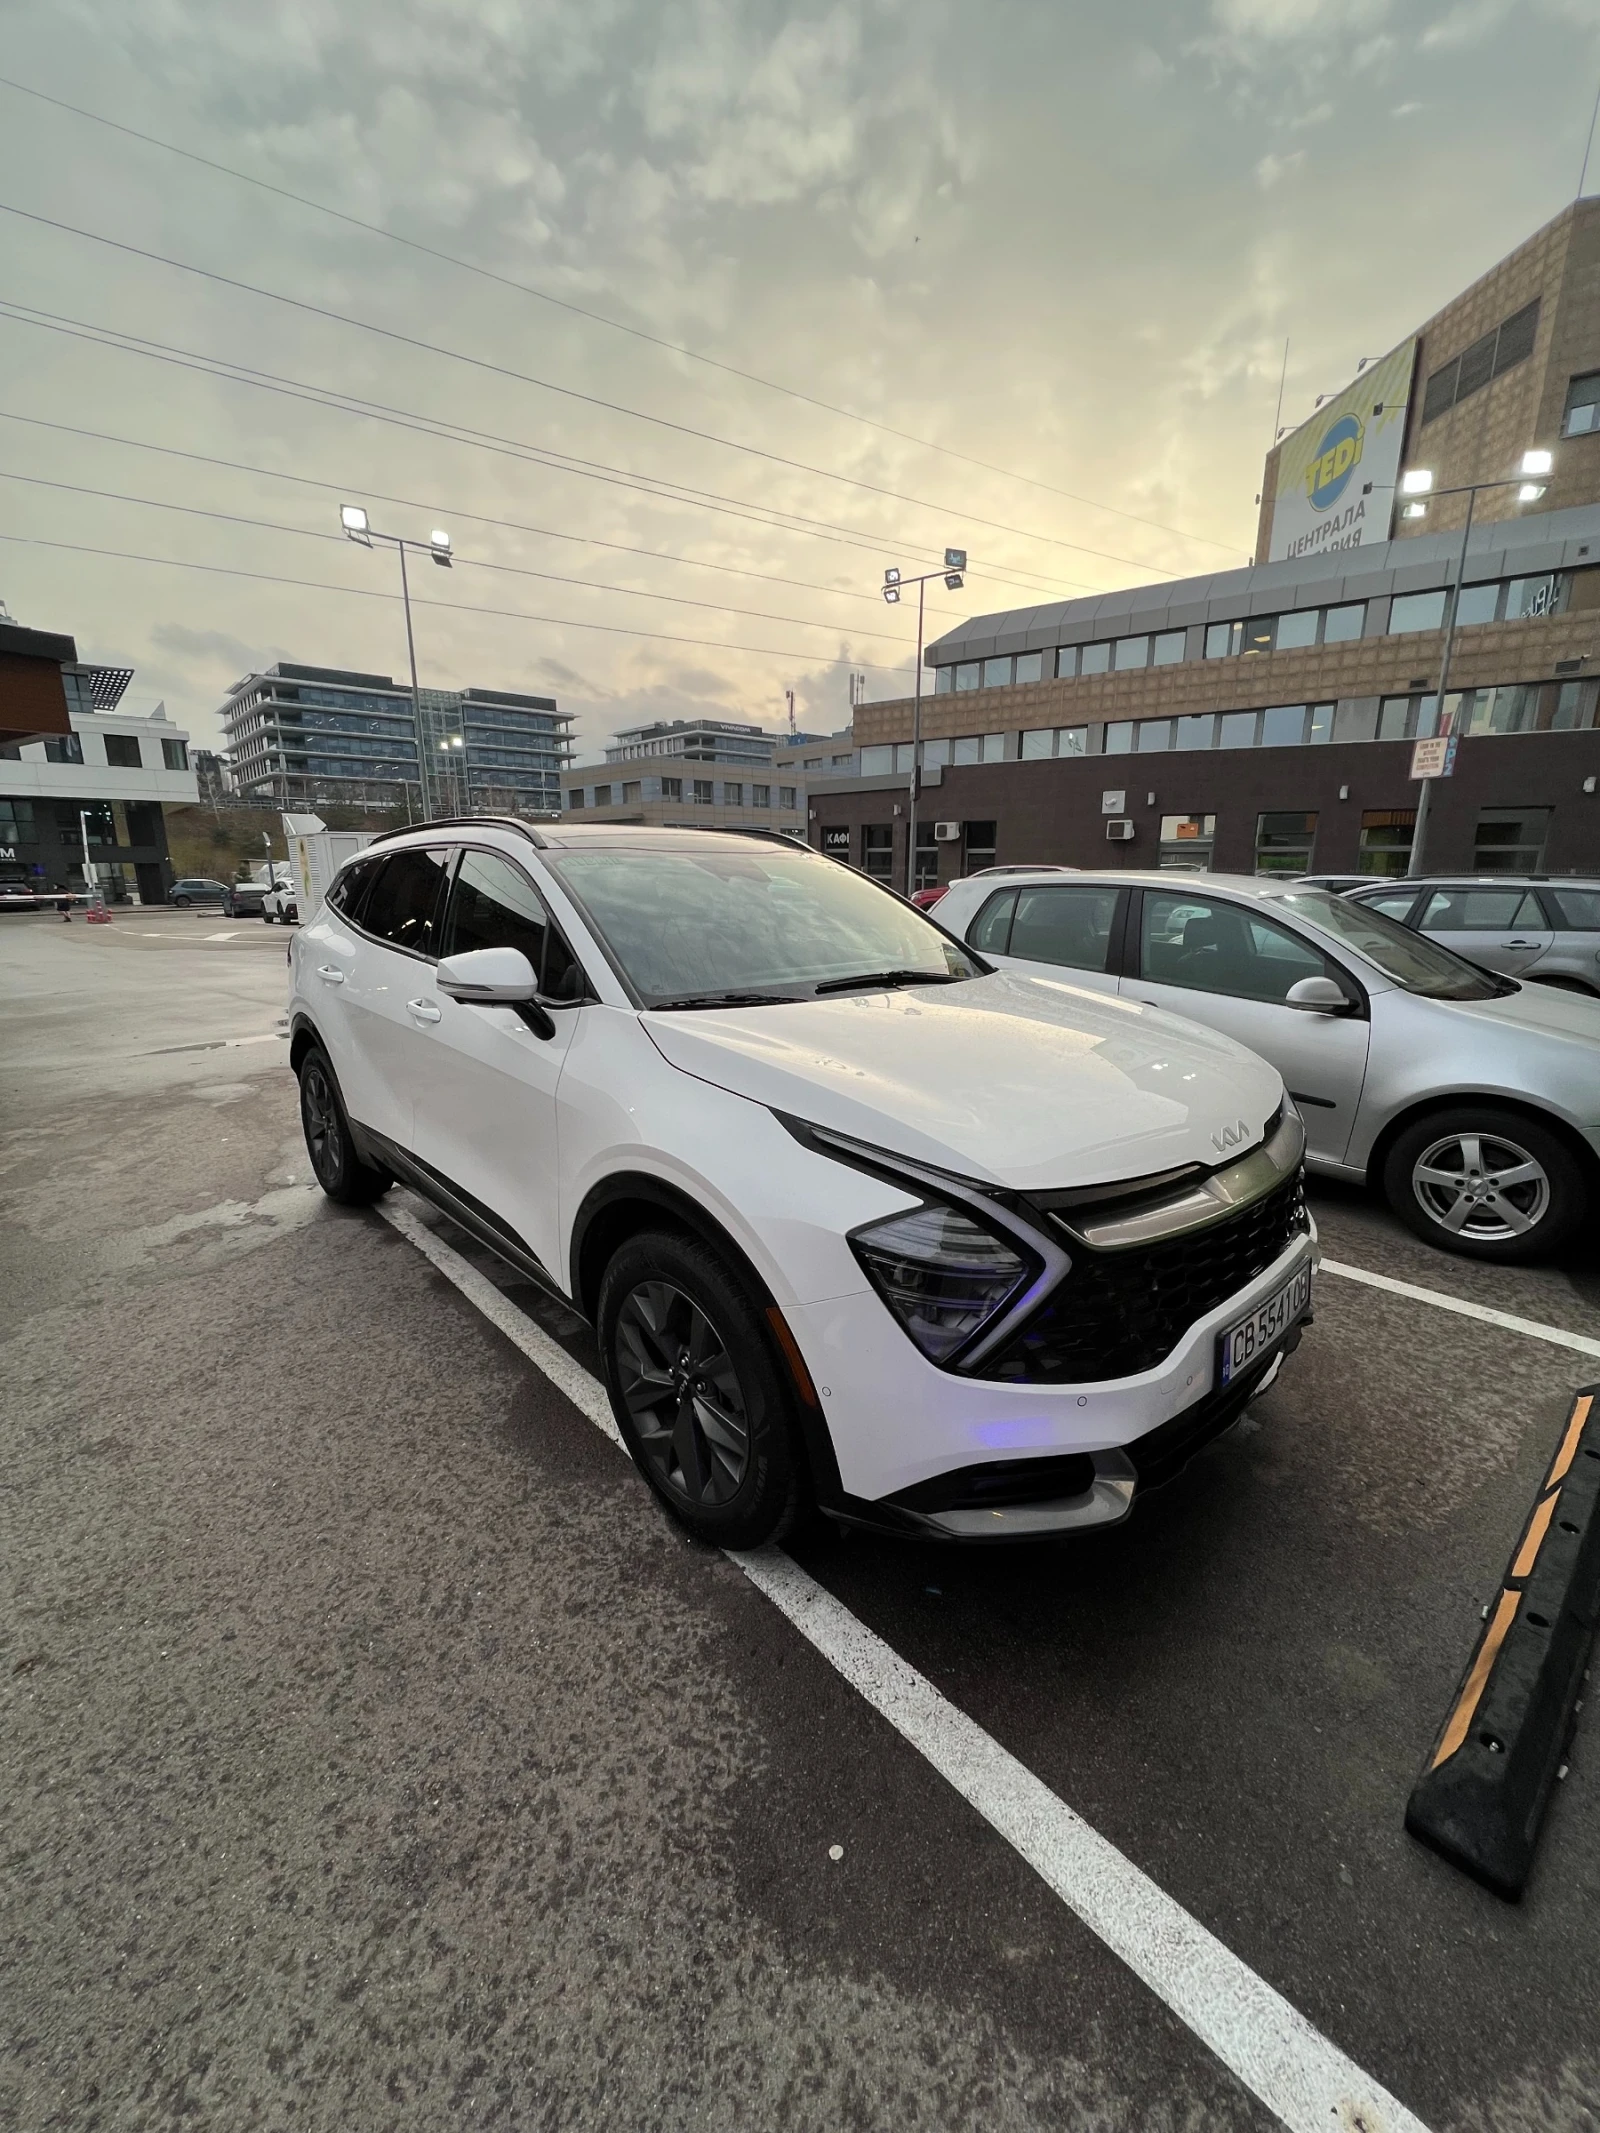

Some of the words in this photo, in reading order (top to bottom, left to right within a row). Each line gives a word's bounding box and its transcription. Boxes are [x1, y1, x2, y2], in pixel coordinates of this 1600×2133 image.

[1286, 500, 1366, 560] ЦЕНТРАЛА
[1233, 1321, 1255, 1368] CB
[1258, 1287, 1290, 1347] 5541
